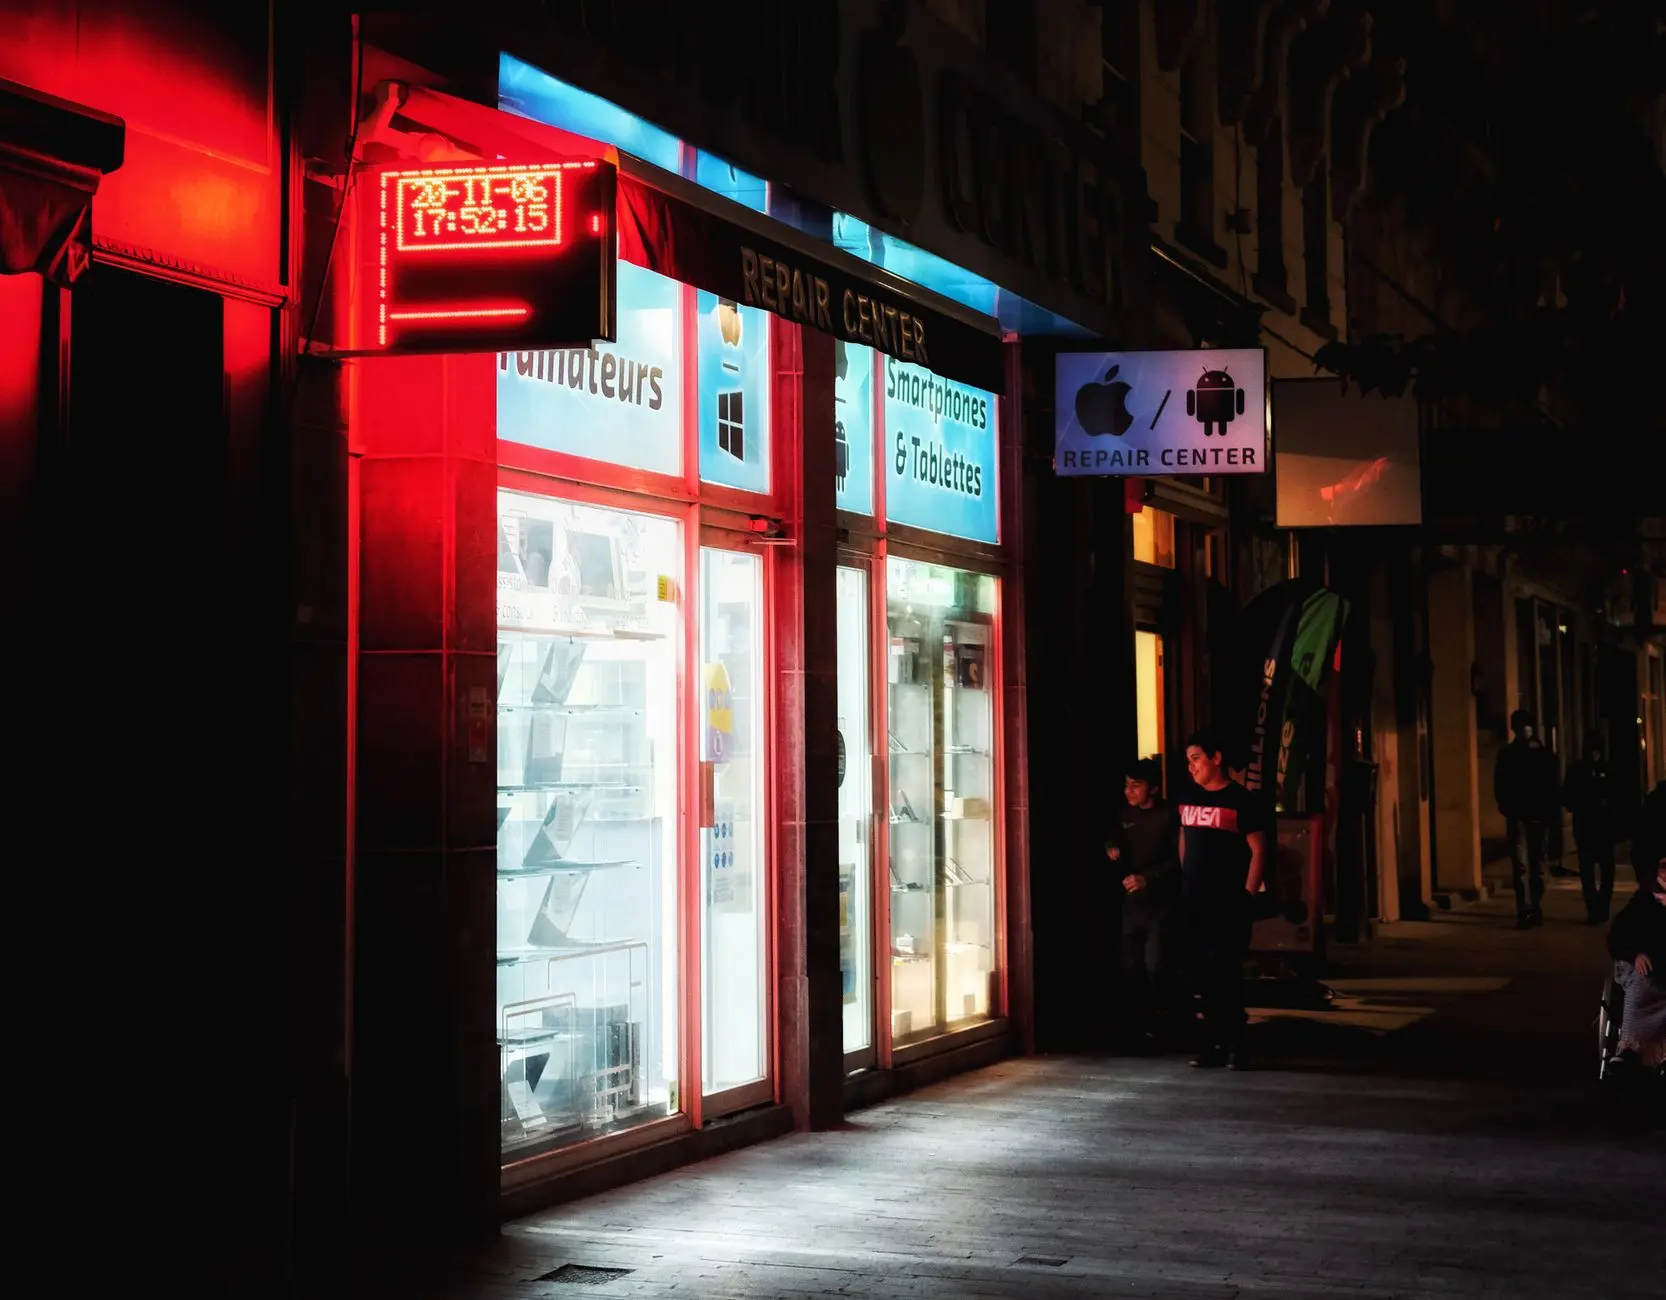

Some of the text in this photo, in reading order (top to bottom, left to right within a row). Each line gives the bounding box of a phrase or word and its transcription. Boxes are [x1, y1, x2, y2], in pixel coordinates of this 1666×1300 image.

[413, 203, 548, 236] 17:52:15
[740, 246, 930, 365] REPAIR CENTER
[887, 356, 987, 430] Smartphones
[896, 431, 981, 496] & Tablettes
[1063, 447, 1256, 468] REPAIR CENTER
[1181, 805, 1220, 828] NASA
